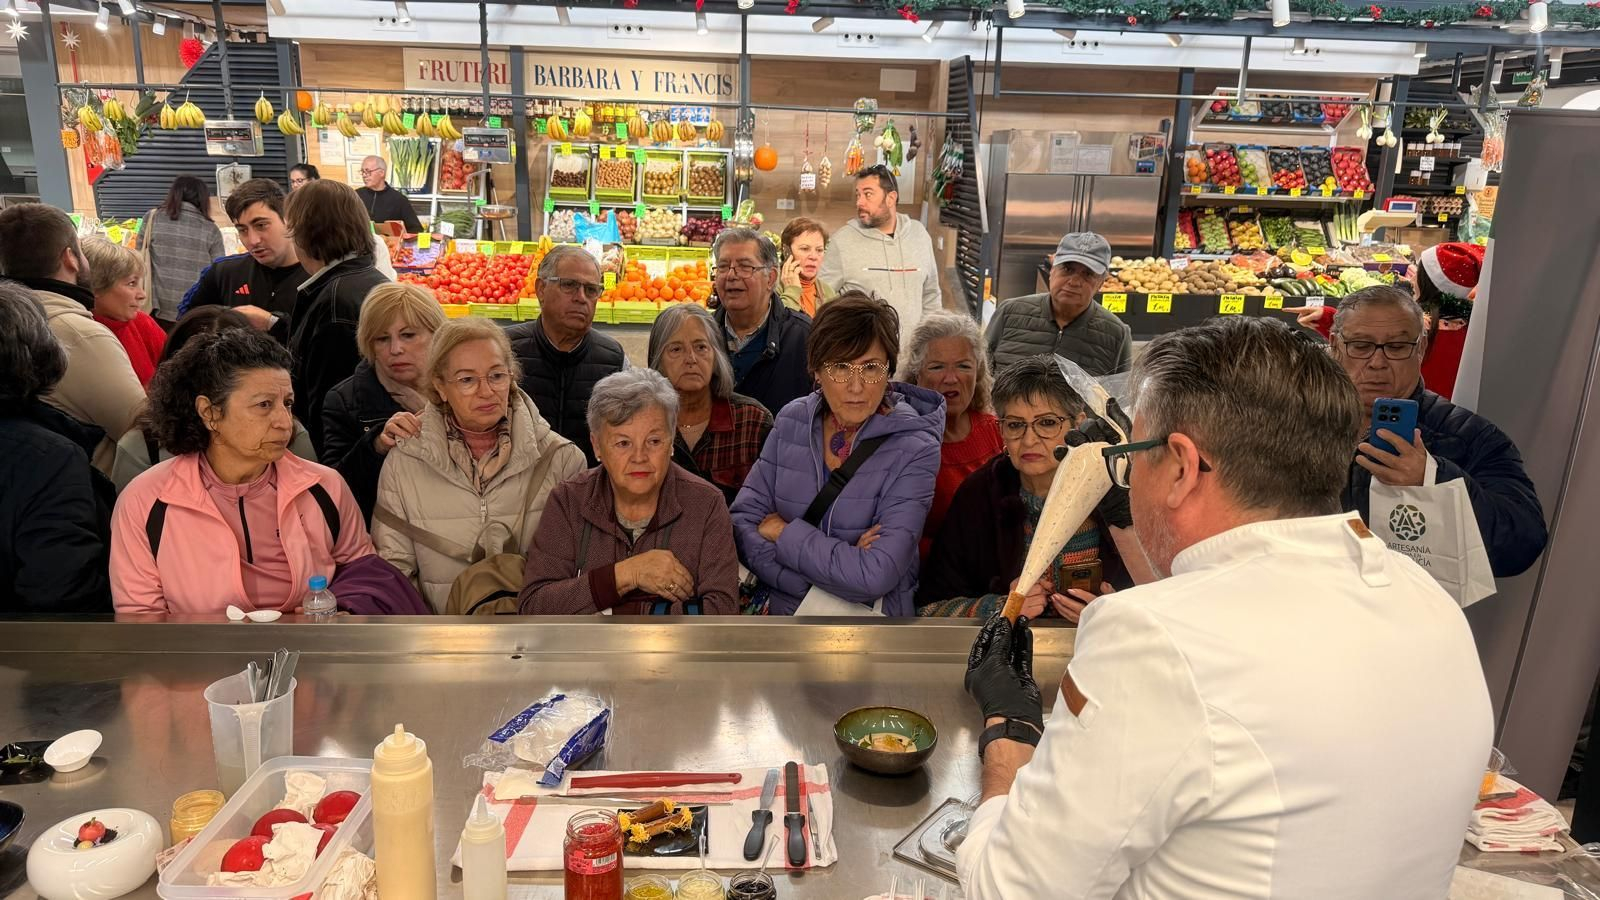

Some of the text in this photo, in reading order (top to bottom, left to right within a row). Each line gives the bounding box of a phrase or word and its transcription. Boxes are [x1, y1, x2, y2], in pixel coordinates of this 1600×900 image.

[418, 59, 512, 84] FRUTERI
[534, 64, 733, 96] BARBARA Y FRANCIS
[1387, 542, 1432, 554] ARTESANÍA
